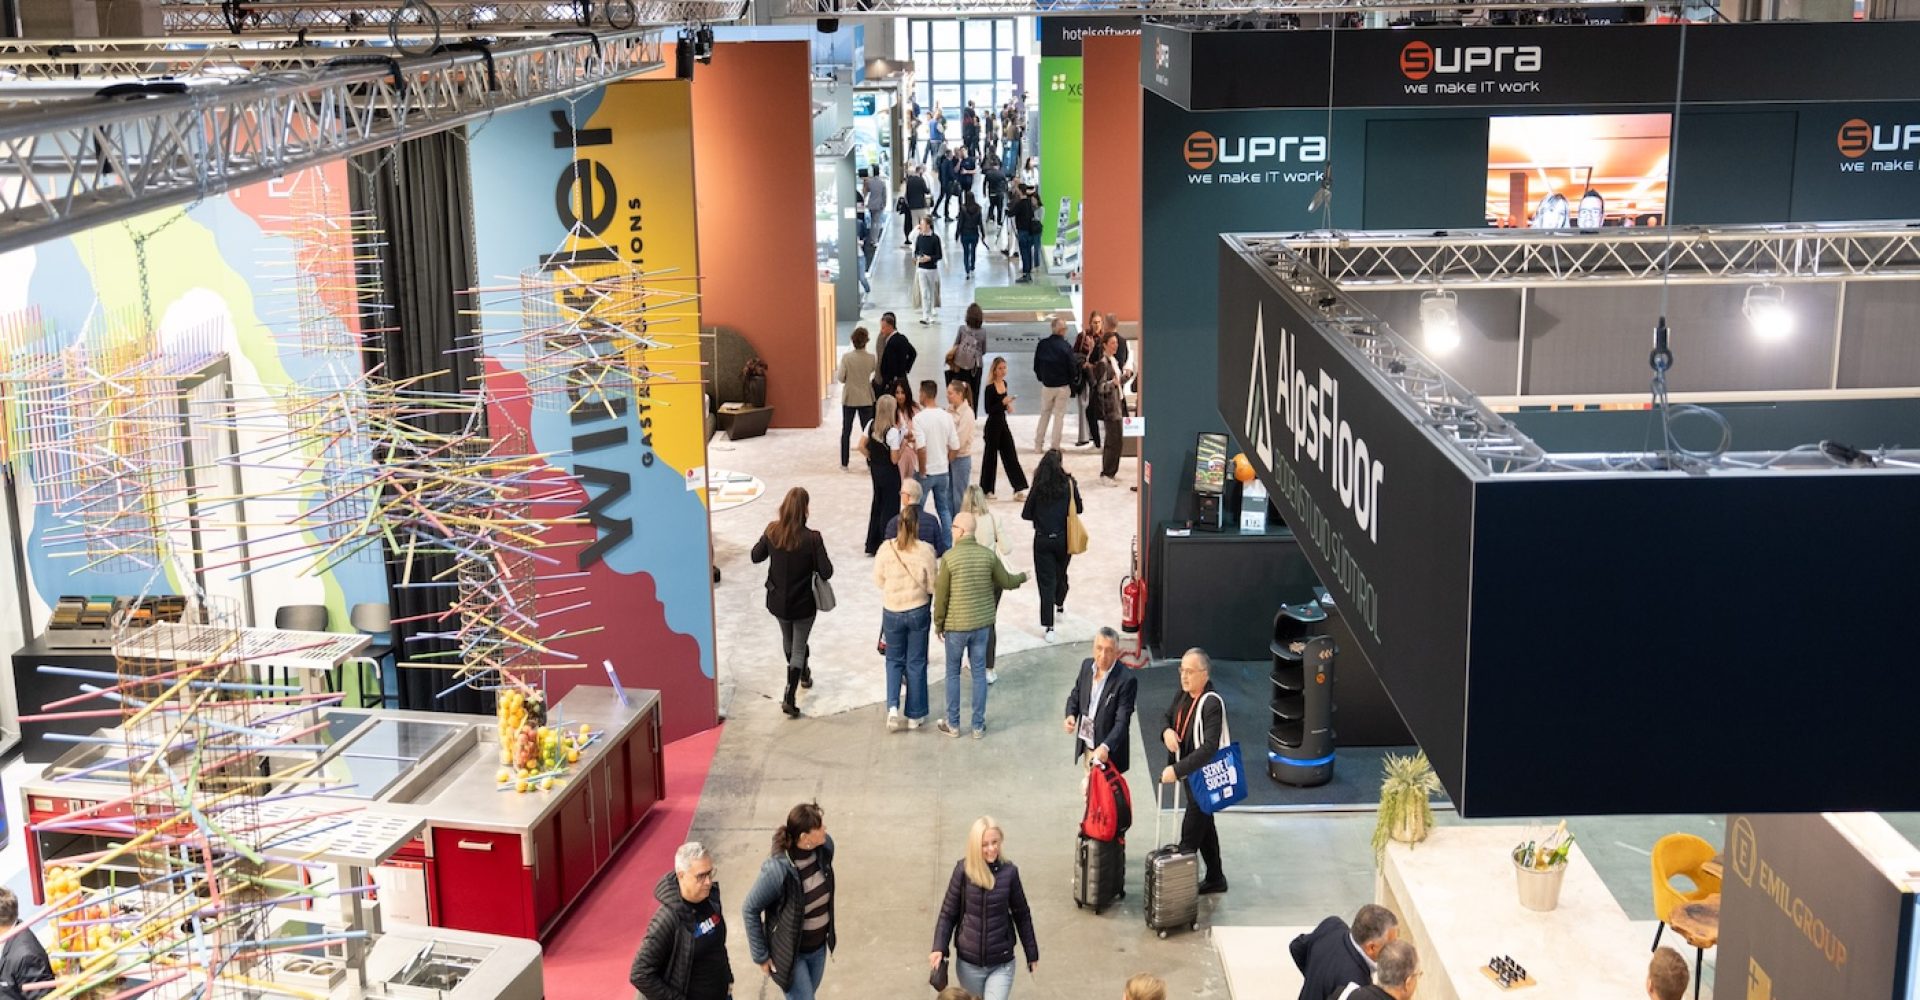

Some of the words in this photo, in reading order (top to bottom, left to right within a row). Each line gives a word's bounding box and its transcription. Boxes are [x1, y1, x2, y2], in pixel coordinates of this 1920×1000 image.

[1481, 81, 1495, 93] IT
[1499, 81, 1541, 94] work
[1265, 171, 1280, 183] IT
[1283, 170, 1325, 183] work
[637, 365, 654, 468] GASTRO
[1276, 327, 1385, 545] AlpsFloor
[1331, 531, 1382, 645] SÜDTIROL
[1759, 858, 1847, 974] EMILGROUP
